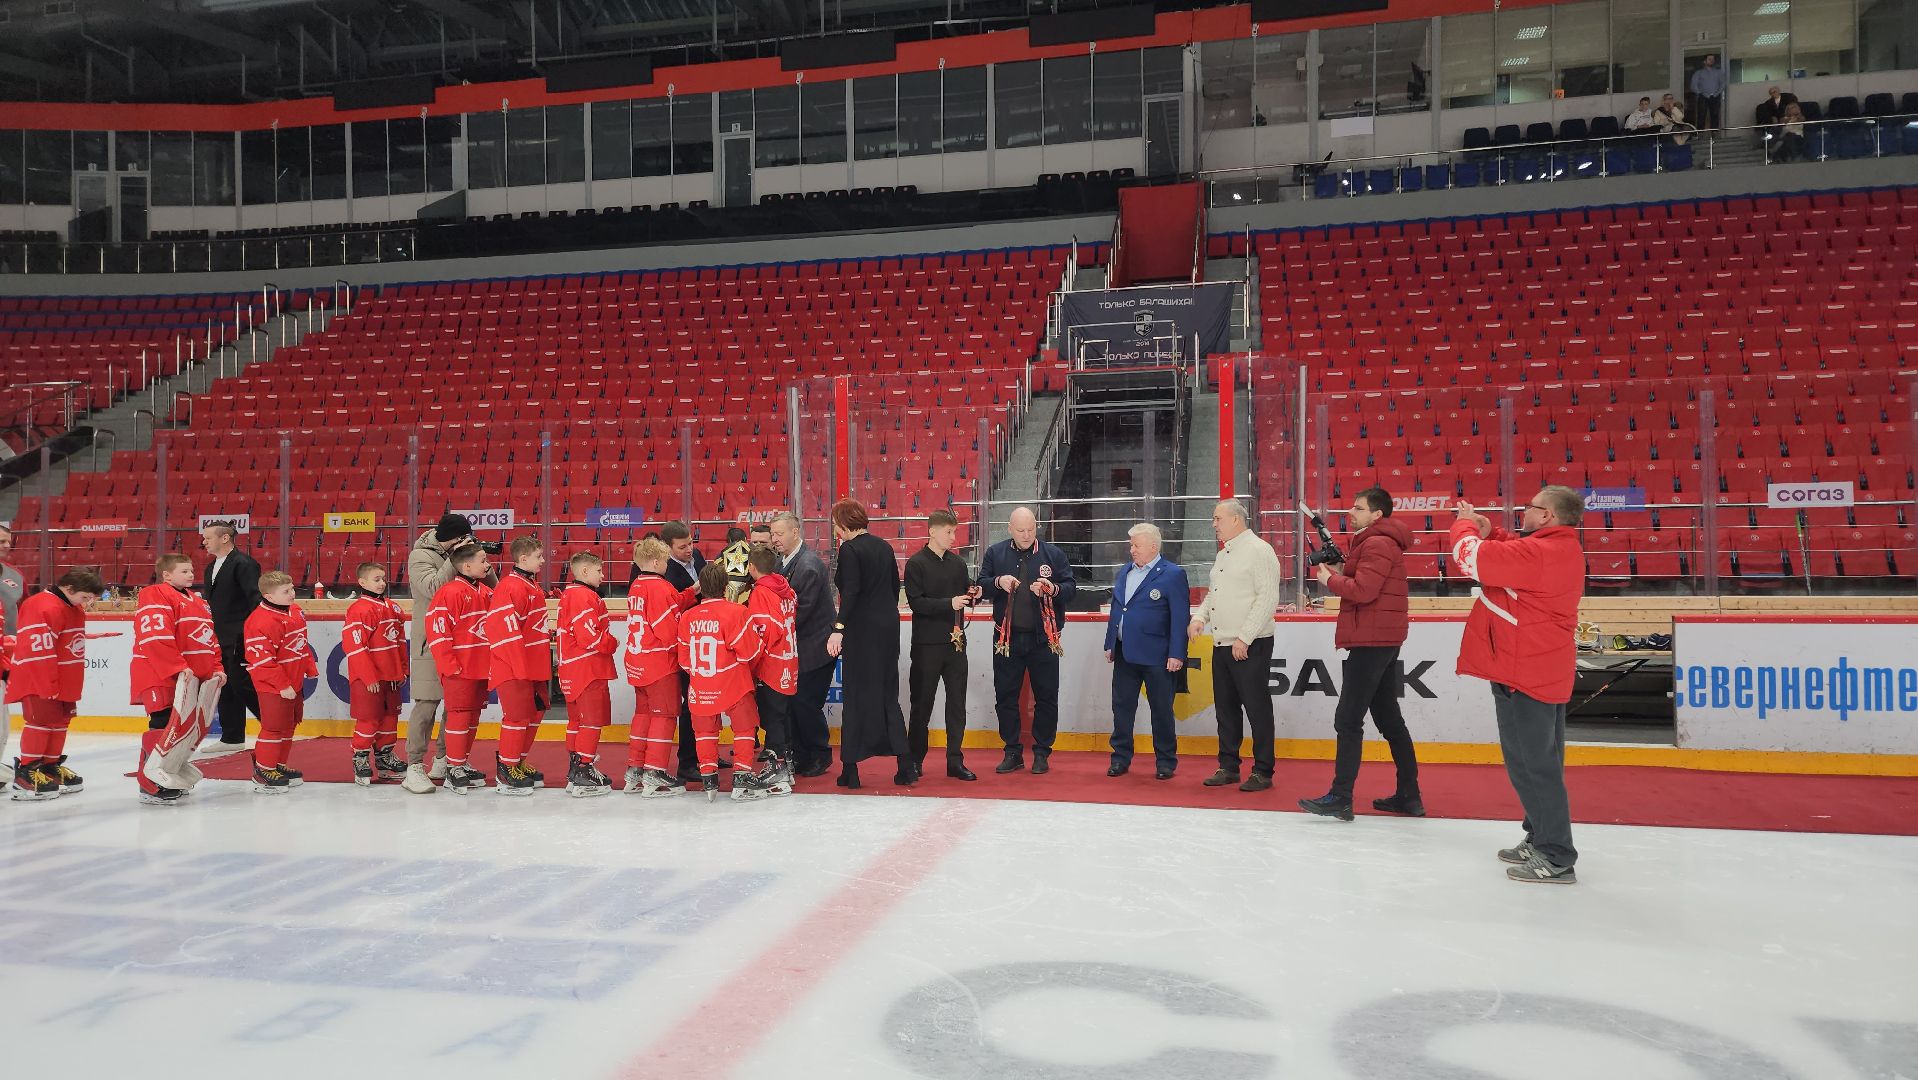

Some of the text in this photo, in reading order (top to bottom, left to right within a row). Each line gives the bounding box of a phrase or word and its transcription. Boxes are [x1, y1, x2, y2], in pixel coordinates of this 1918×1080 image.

[1099, 299, 1136, 309] ТОЛЬКО
[81, 524, 127, 532] OLIMPBET
[343, 518, 370, 526] БАНК
[140, 613, 165, 633] 23
[432, 617, 446, 634] 48
[503, 613, 519, 632] 11
[30, 632, 54, 652] 20
[690, 636, 717, 678] 19
